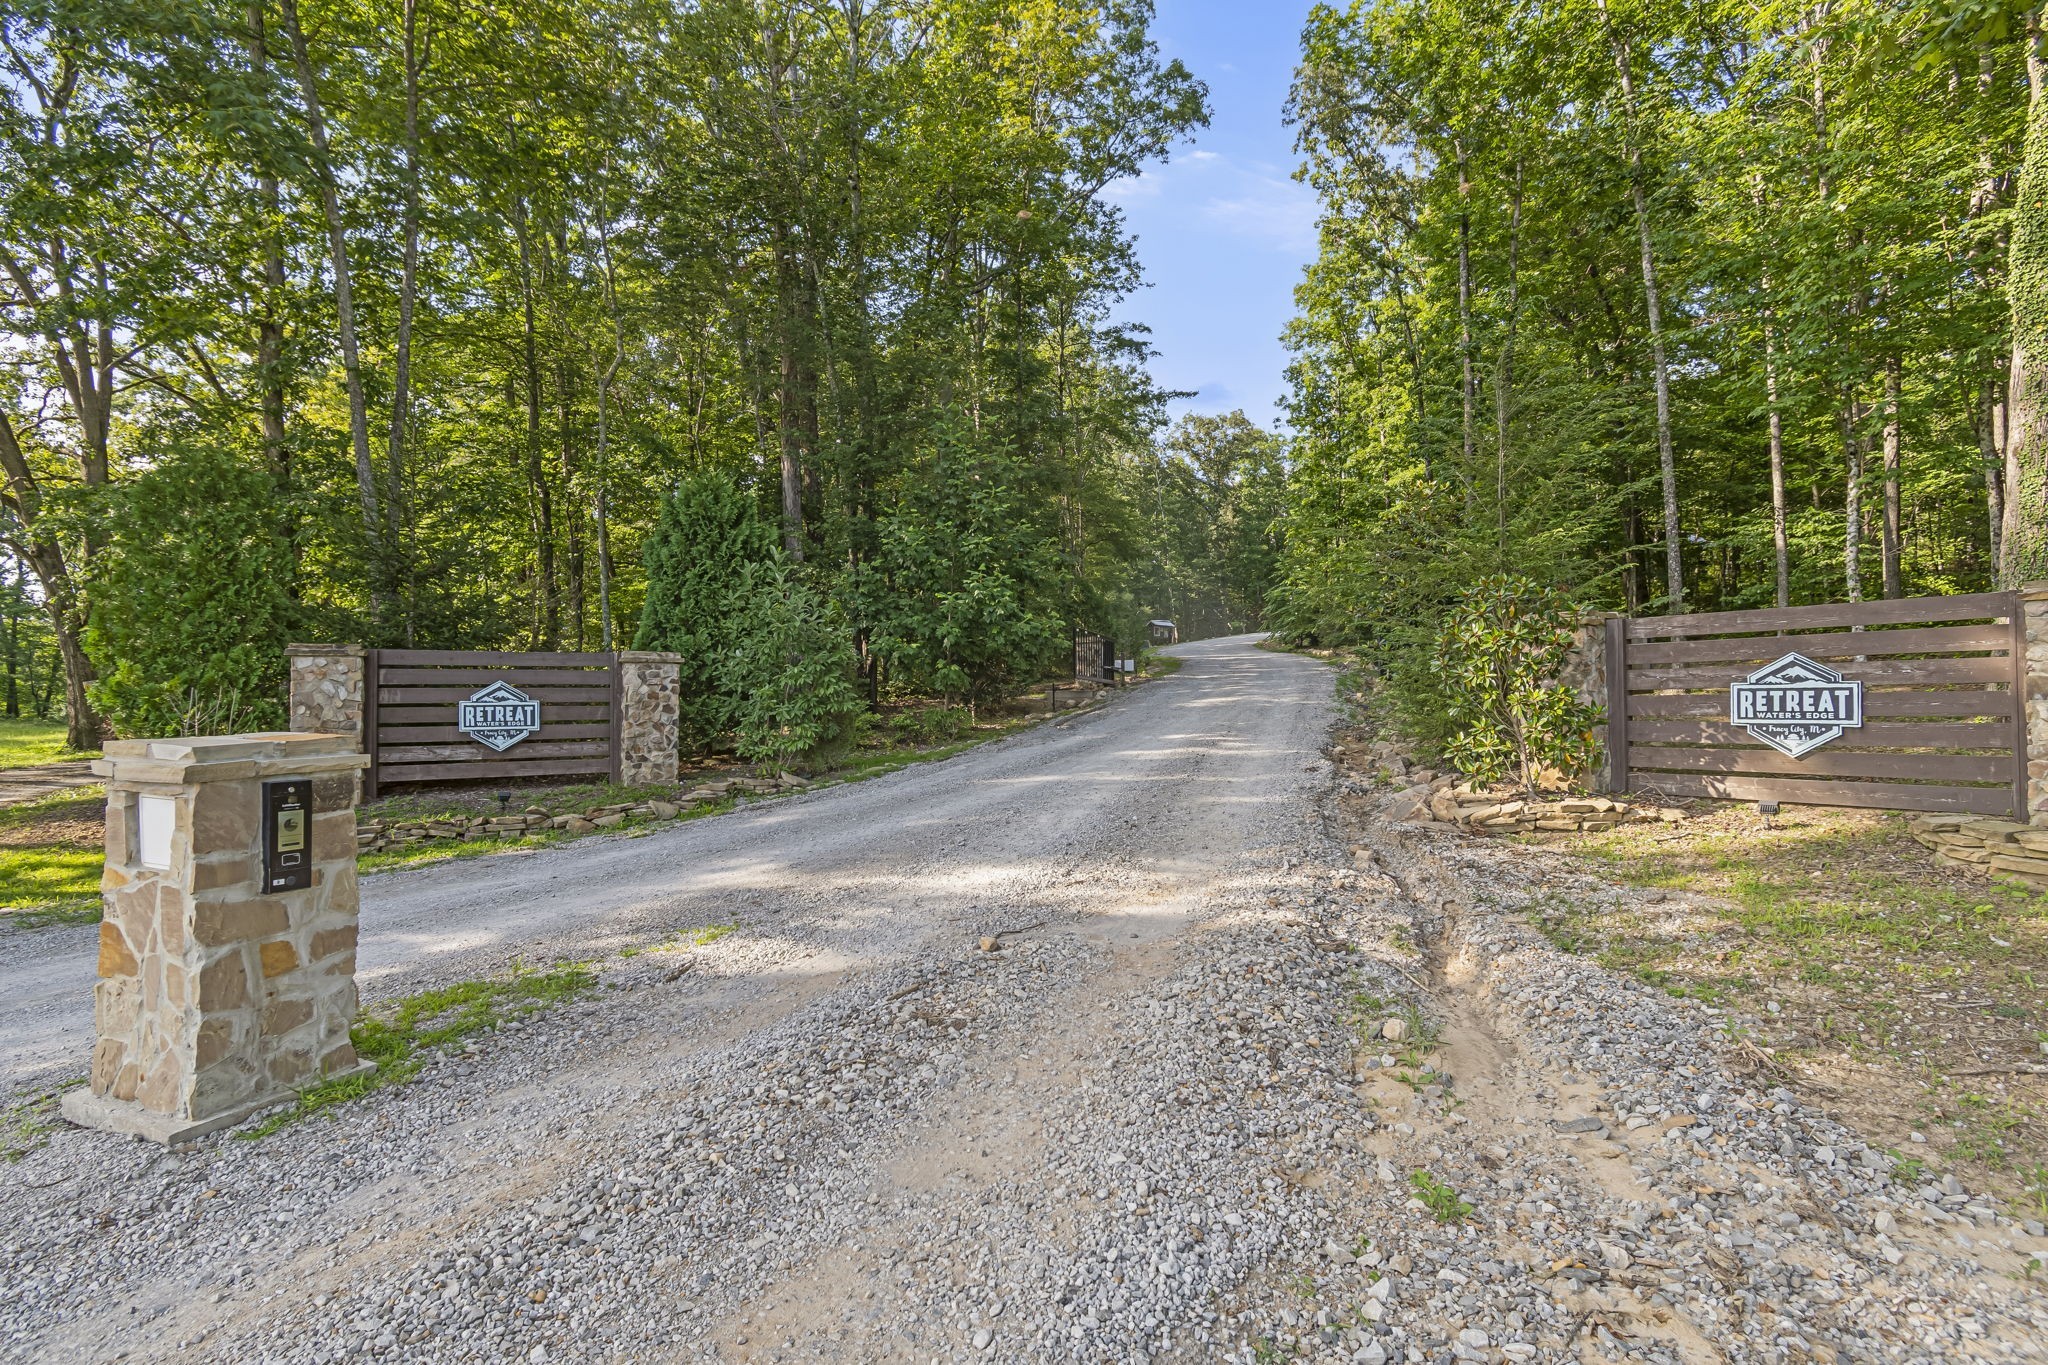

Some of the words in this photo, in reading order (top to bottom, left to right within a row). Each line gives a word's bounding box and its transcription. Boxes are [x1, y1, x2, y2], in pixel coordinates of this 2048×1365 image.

[1740, 690, 1850, 719] RETREAT
[466, 706, 533, 726] RETREAT
[1768, 724, 1789, 736] Tracy
